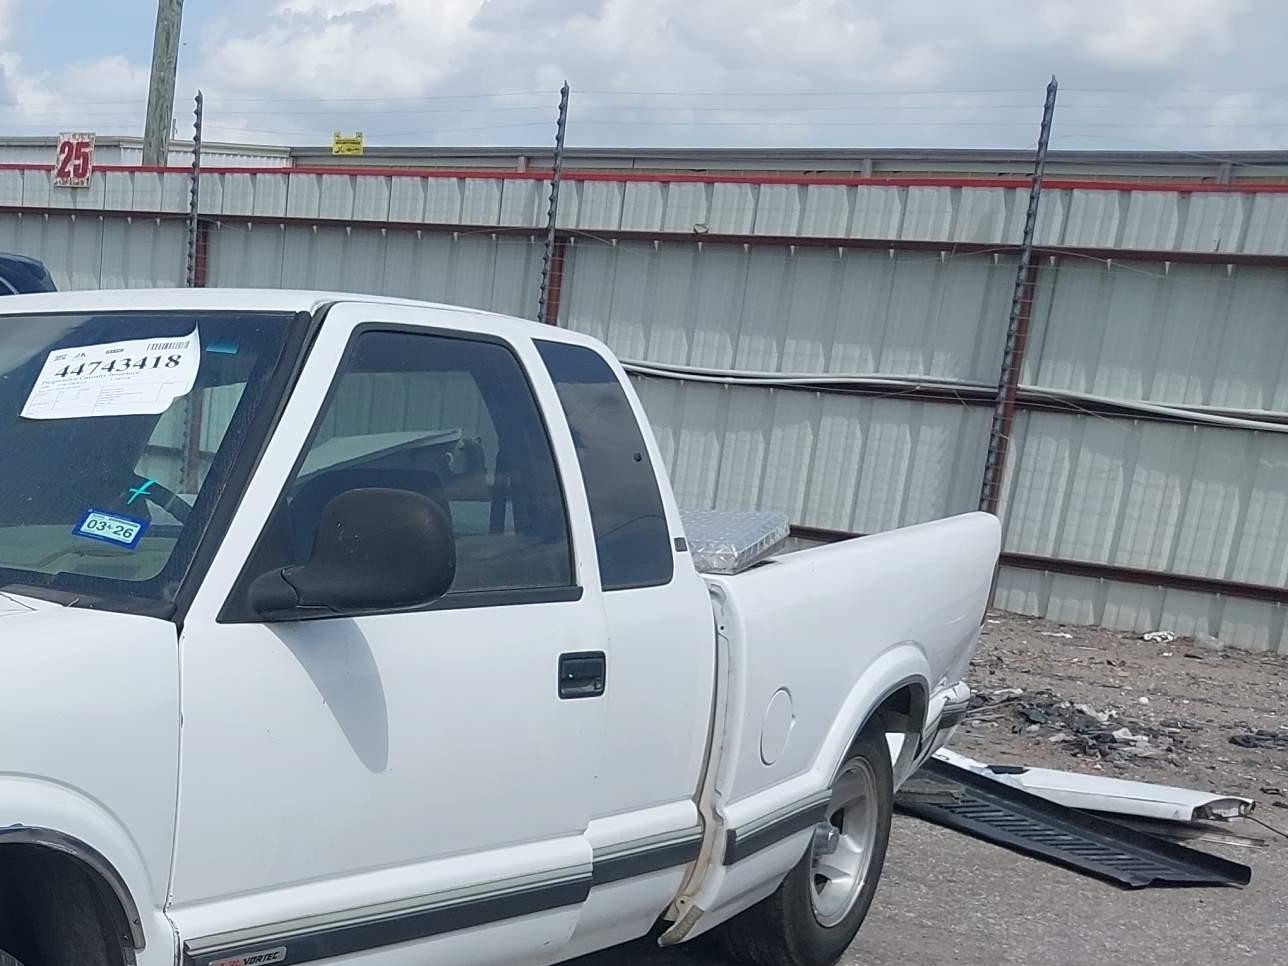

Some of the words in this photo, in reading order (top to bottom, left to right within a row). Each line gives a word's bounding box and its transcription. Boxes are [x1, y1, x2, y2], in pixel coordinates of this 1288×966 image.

[59, 141, 90, 179] 25
[54, 354, 182, 378] 44743418
[86, 519, 107, 531] 03
[112, 525, 134, 538] 26
[243, 952, 280, 966] VORTEC
